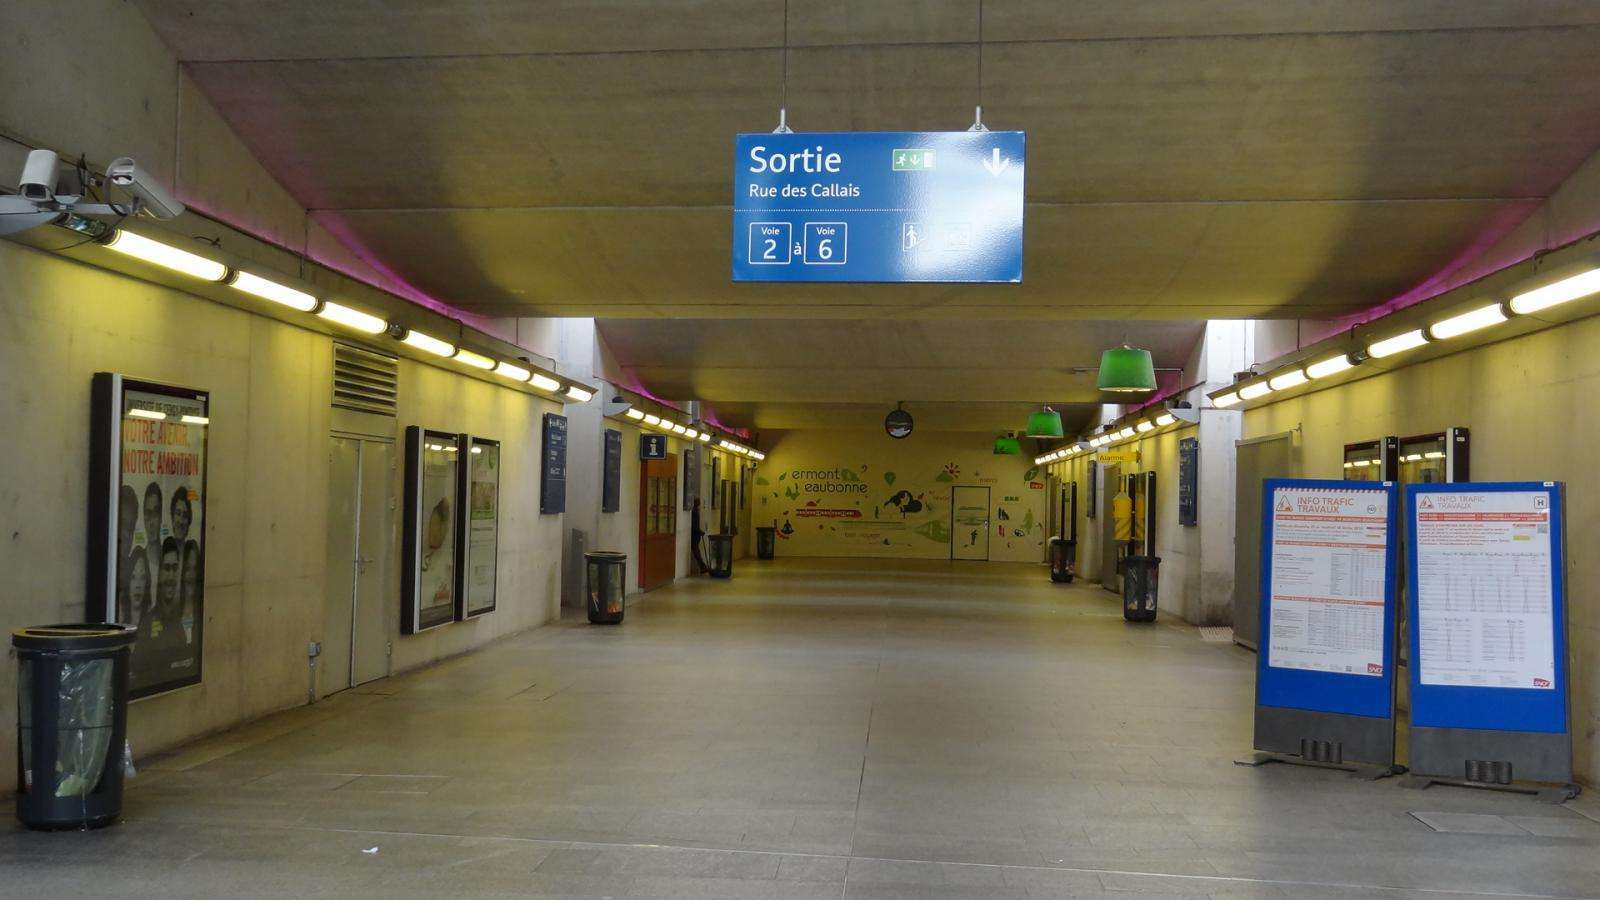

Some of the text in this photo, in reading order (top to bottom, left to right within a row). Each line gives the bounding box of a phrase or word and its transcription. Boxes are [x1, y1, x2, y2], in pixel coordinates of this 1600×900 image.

[750, 146, 842, 173] Sortie
[750, 183, 860, 198] Rue des Callais
[761, 227, 780, 236] Voie
[816, 227, 835, 236] Voie
[763, 239, 832, 260] 2 à 6
[792, 468, 841, 480] ermont
[804, 482, 868, 493] eaubonne
[1297, 497, 1354, 506] INFO TRAFIC
[1298, 505, 1339, 514] TRAVAUX
